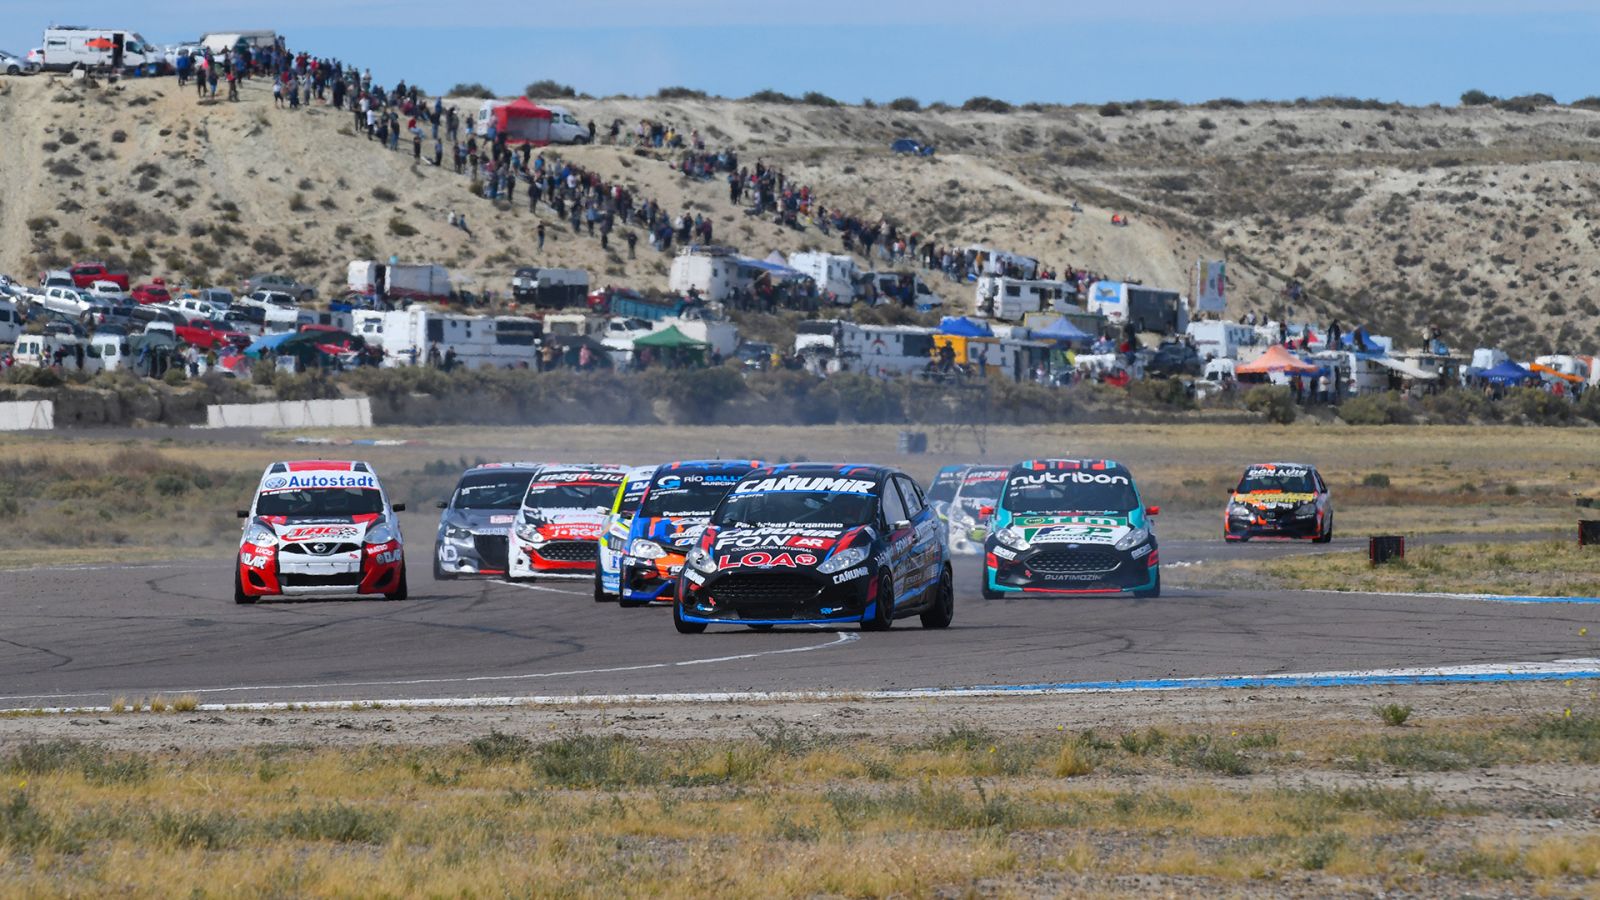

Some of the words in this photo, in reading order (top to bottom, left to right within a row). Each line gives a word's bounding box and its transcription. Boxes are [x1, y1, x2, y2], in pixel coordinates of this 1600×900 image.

[289, 475, 374, 487] Autostadt
[1011, 472, 1128, 485] nutribon
[788, 521, 843, 529] Pergamino
[718, 552, 797, 571] LOA
